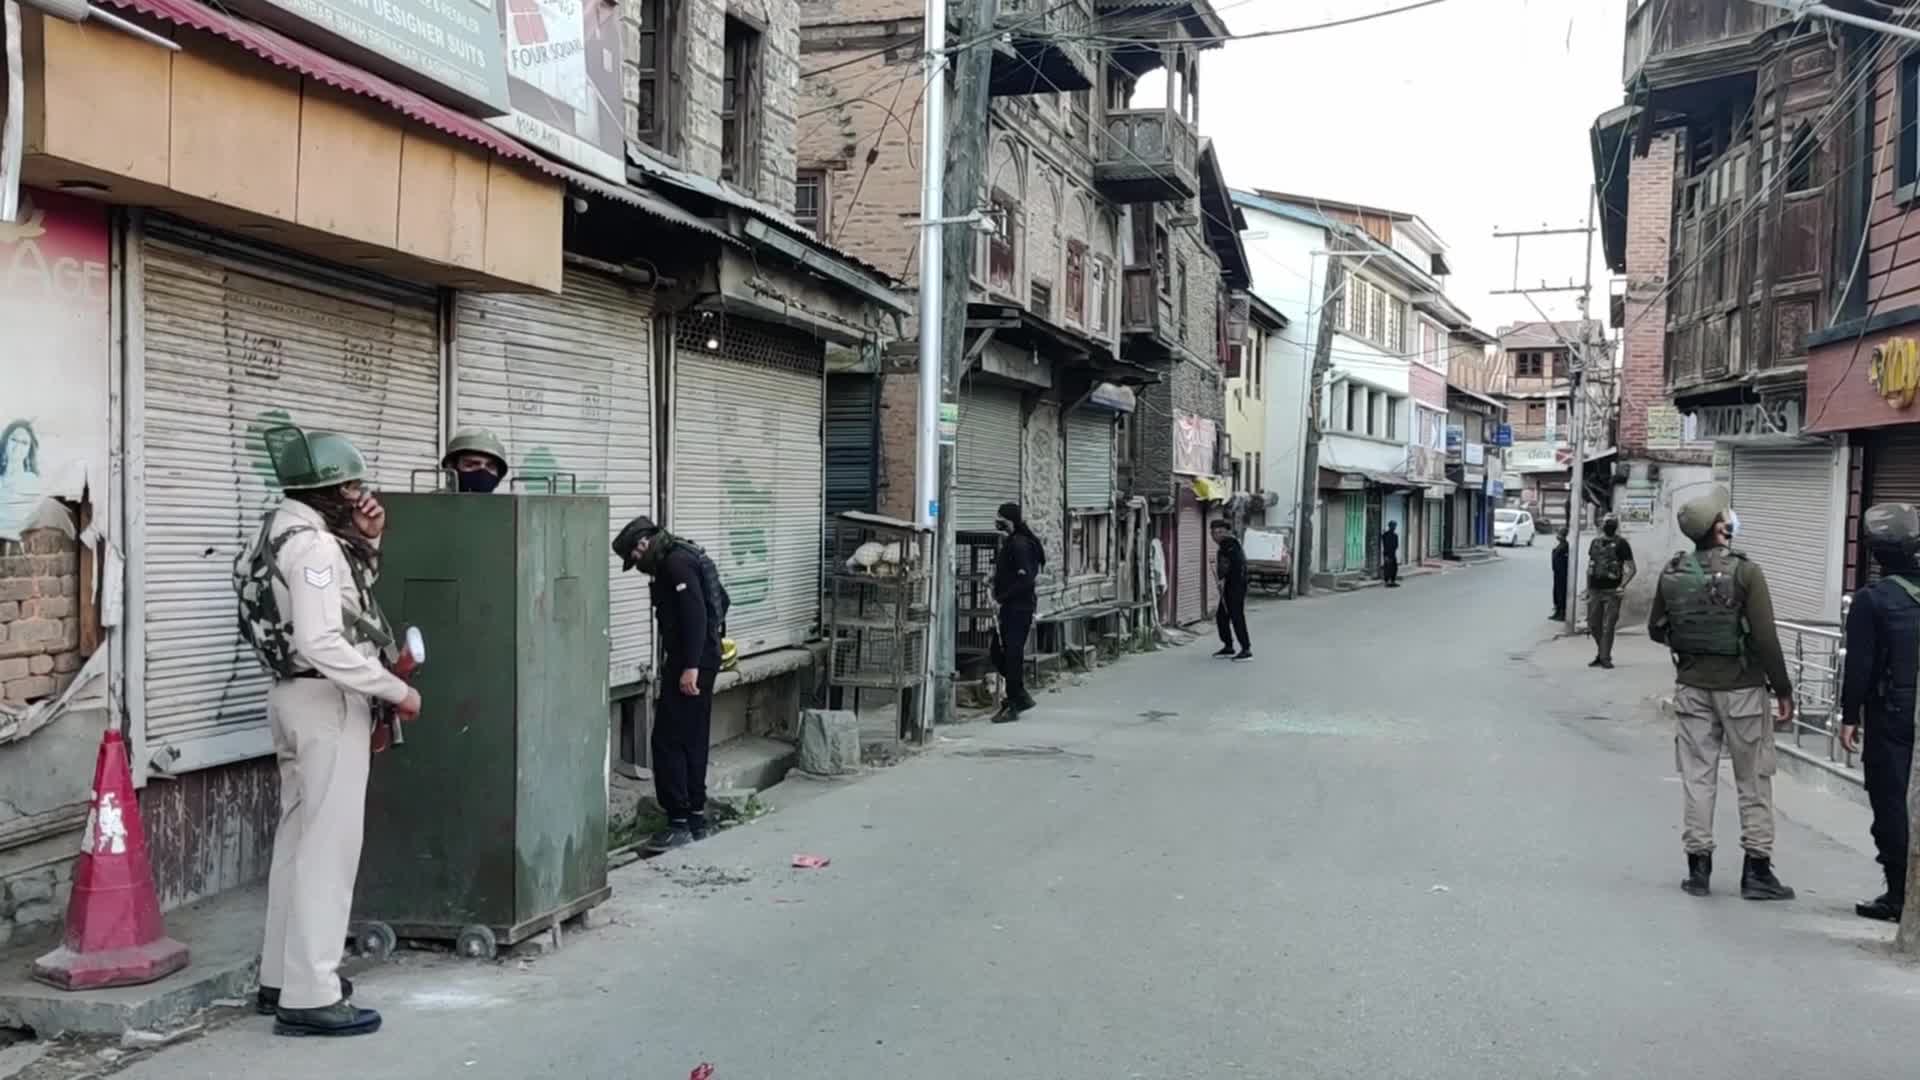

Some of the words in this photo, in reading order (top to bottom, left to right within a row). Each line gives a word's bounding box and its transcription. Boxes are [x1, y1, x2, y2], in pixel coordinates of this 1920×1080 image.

[373, 0, 445, 48] DESIGNER
[447, 33, 487, 68] SUITS
[511, 47, 548, 70] FOUR
